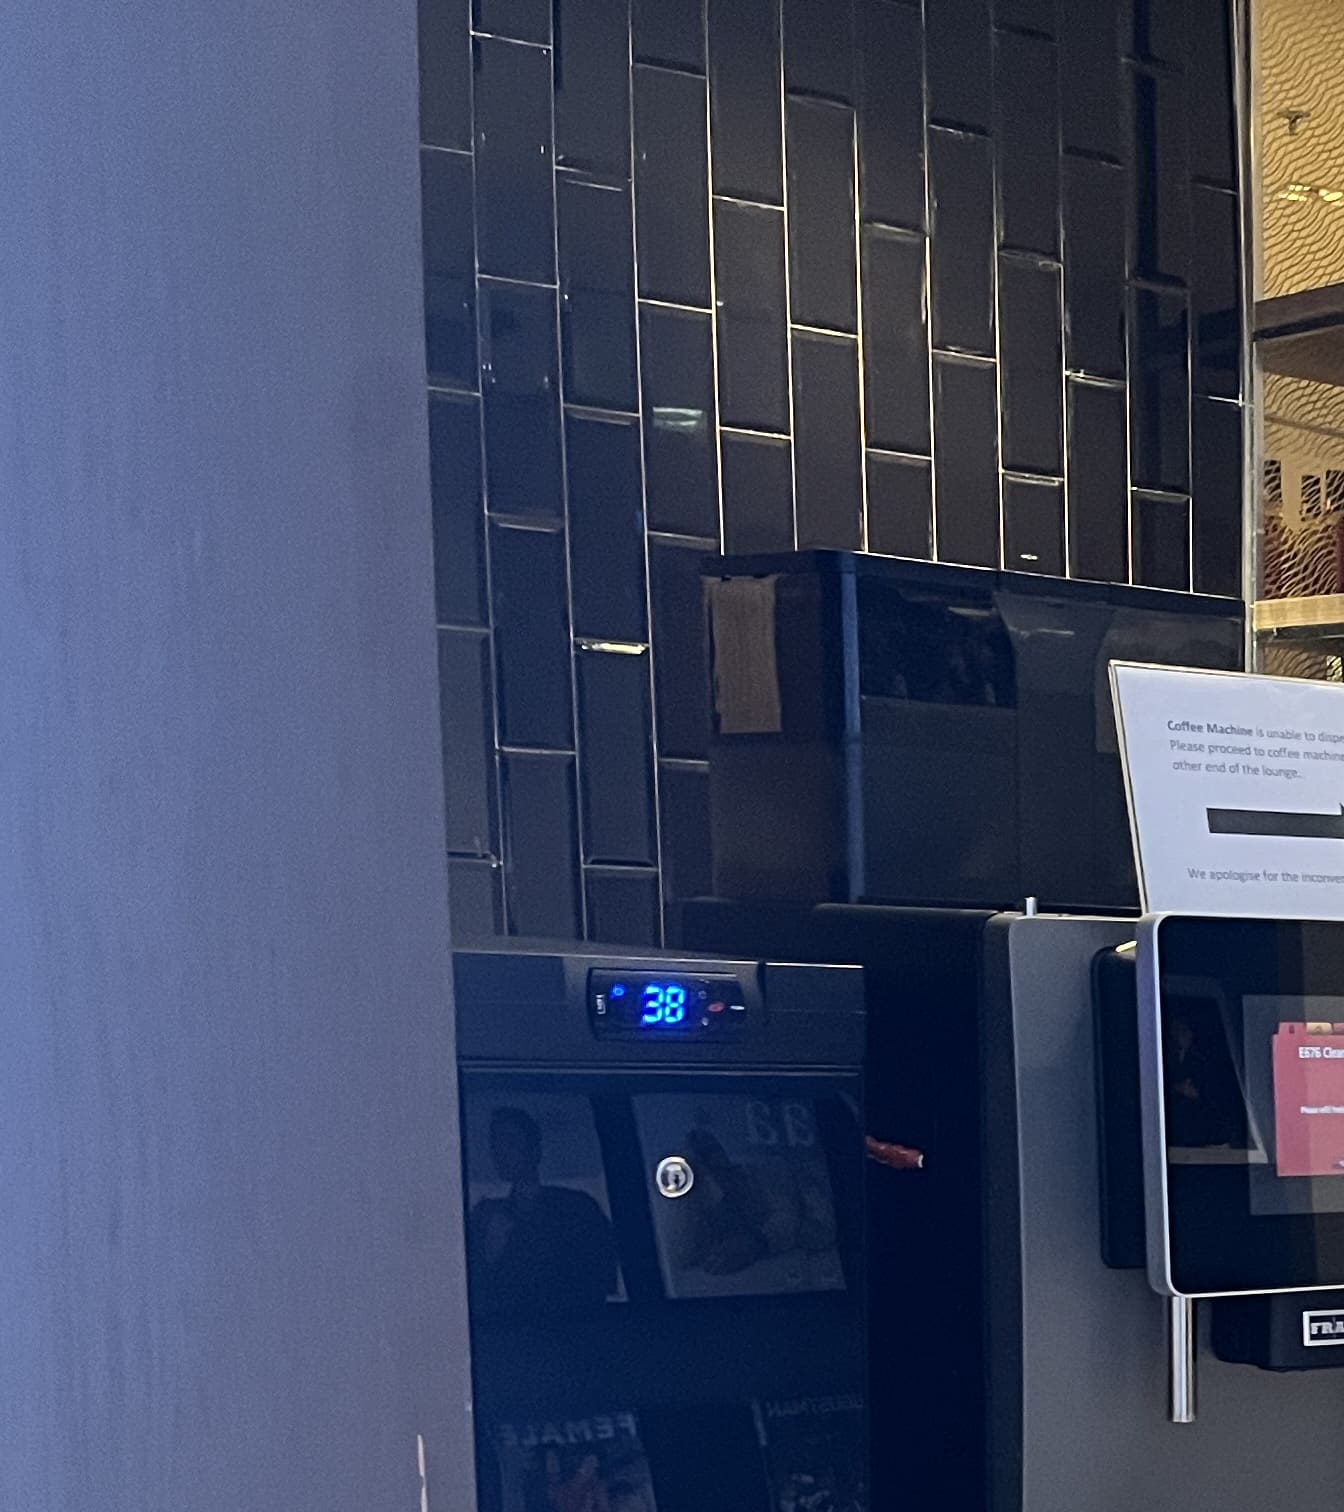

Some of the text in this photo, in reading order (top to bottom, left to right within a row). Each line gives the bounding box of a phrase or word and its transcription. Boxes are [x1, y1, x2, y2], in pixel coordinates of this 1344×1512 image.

[1167, 720, 1204, 733] Coffee
[1206, 722, 1253, 737] Machine
[1256, 727, 1265, 738] is
[1266, 729, 1301, 740] unable
[1304, 732, 1316, 742] to
[1169, 739, 1205, 753] Please
[1208, 744, 1251, 757] proceed
[1254, 746, 1266, 757] to
[1267, 747, 1300, 759] coffee
[1172, 761, 1202, 772] other
[1205, 763, 1227, 774] end
[1228, 763, 1240, 774] of
[1242, 764, 1260, 776] the
[1186, 867, 1207, 880] We
[1262, 868, 1279, 881] for
[1280, 871, 1299, 882] the
[643, 985, 686, 1024] 38
